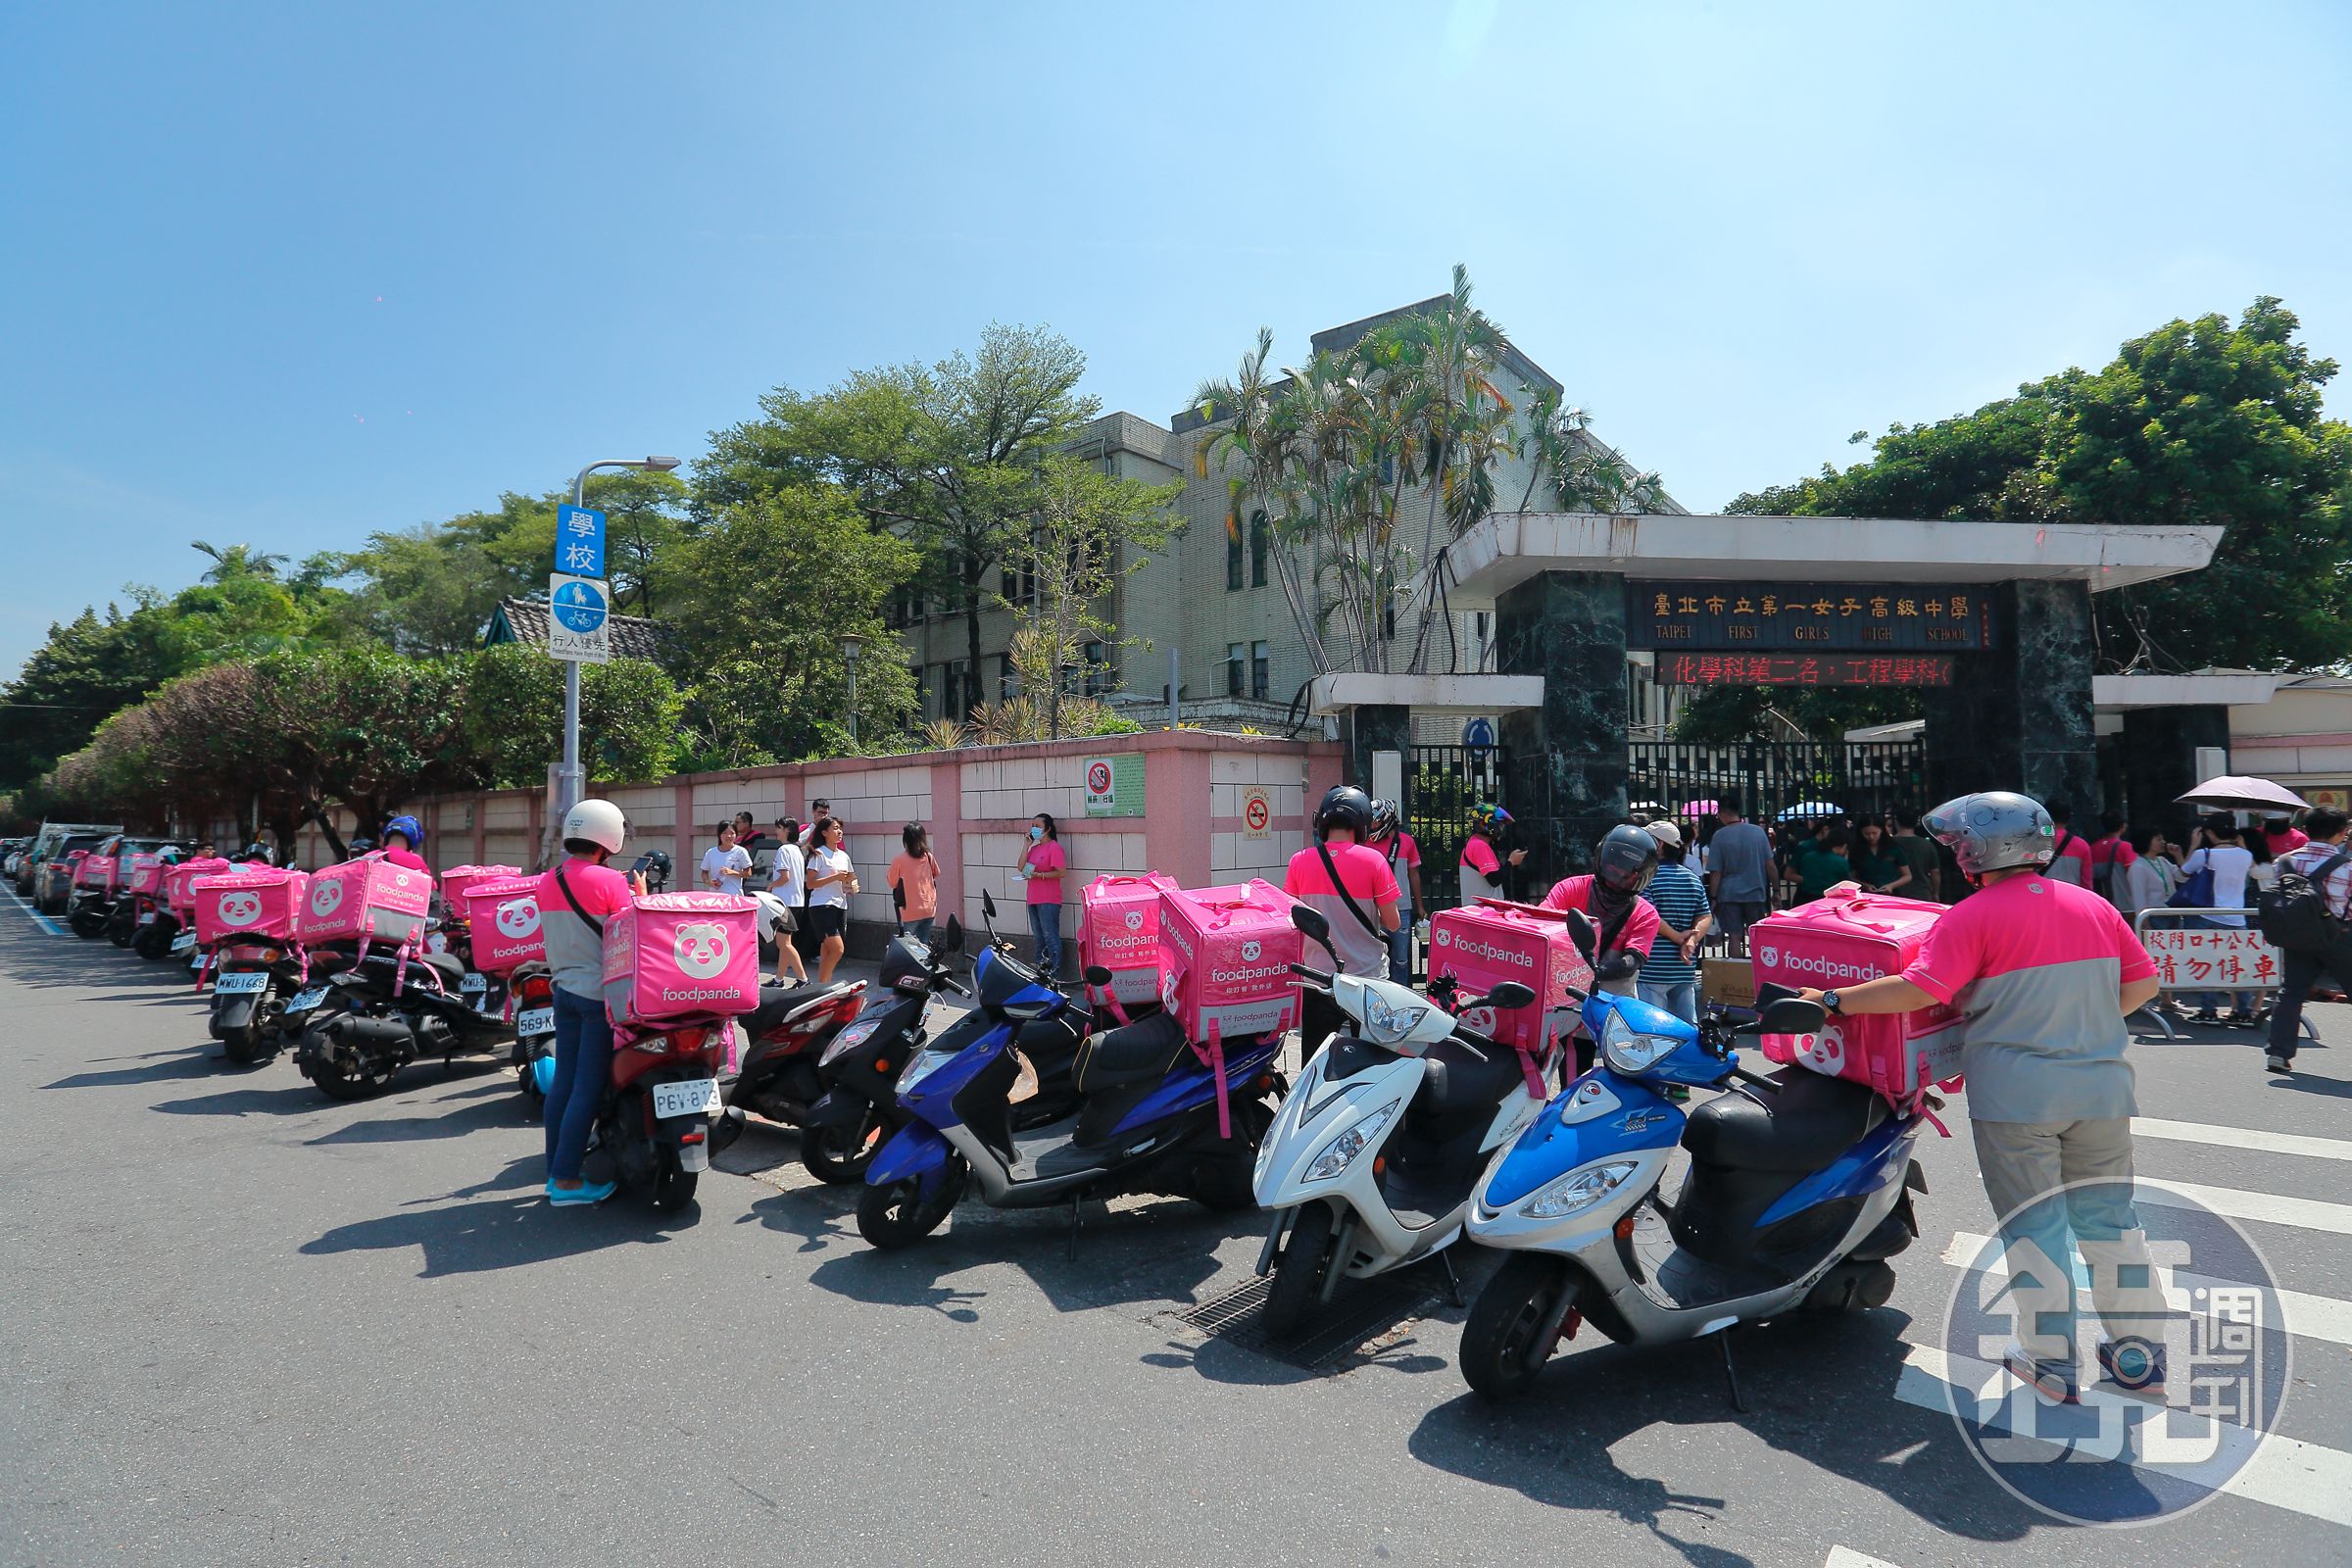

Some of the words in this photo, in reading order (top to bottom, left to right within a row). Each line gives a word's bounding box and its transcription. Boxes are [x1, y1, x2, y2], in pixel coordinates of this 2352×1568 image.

[564, 511, 596, 571] 學校
[1654, 592, 1969, 619] 臺北市立第一女子高級中學
[1655, 625, 1691, 639] TAIPEI
[1729, 625, 1759, 639] FIRST
[1794, 626, 1830, 640] GIRLS
[1864, 627, 1892, 641] HIGH
[1928, 627, 1969, 641] SCHOOL
[553, 634, 606, 651] 行人優先
[376, 884, 424, 903] foodpanda
[305, 918, 346, 933] foodpanda
[1100, 935, 1158, 949] foodpan
[1167, 916, 1194, 960] foodpanda
[2149, 931, 2275, 951] 校門口十公尺
[493, 942, 547, 958] foodpan
[1453, 935, 1534, 968] foodpanda
[1211, 961, 1289, 983] foodpanda
[1784, 951, 1886, 980] foodpanda
[2152, 954, 2278, 984] 請勿停車
[218, 977, 266, 989] MWU-1668
[462, 978, 486, 988] MWU-5
[1125, 978, 1157, 987] foodpan
[662, 987, 741, 1003] foodpanda
[519, 1015, 553, 1032] 569-K
[1235, 1011, 1278, 1023] foodpanda
